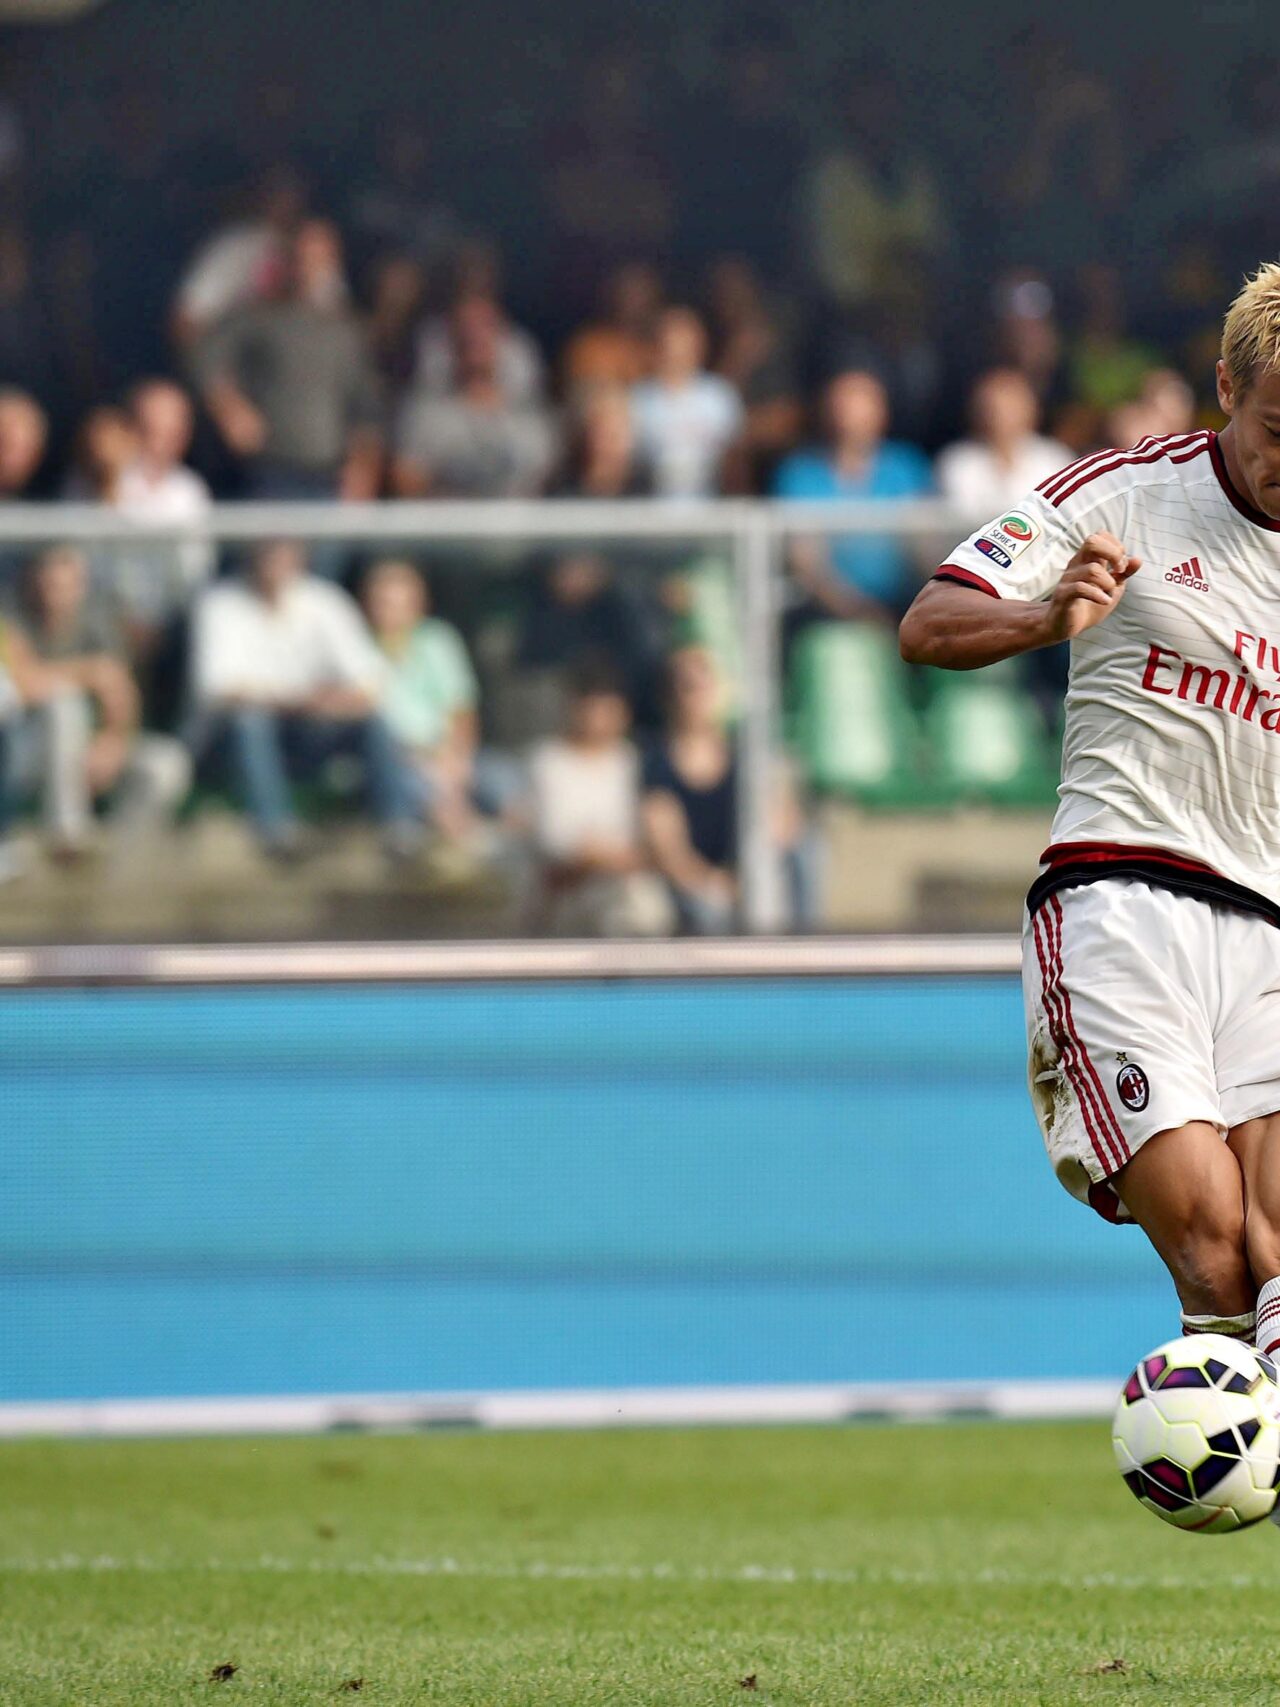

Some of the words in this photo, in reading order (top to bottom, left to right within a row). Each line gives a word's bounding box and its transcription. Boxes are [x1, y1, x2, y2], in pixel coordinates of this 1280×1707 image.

[990, 529, 1011, 545] SERIE
[1008, 543, 1017, 551] A
[988, 547, 1008, 565] TIM
[1164, 572, 1209, 592] adidas
